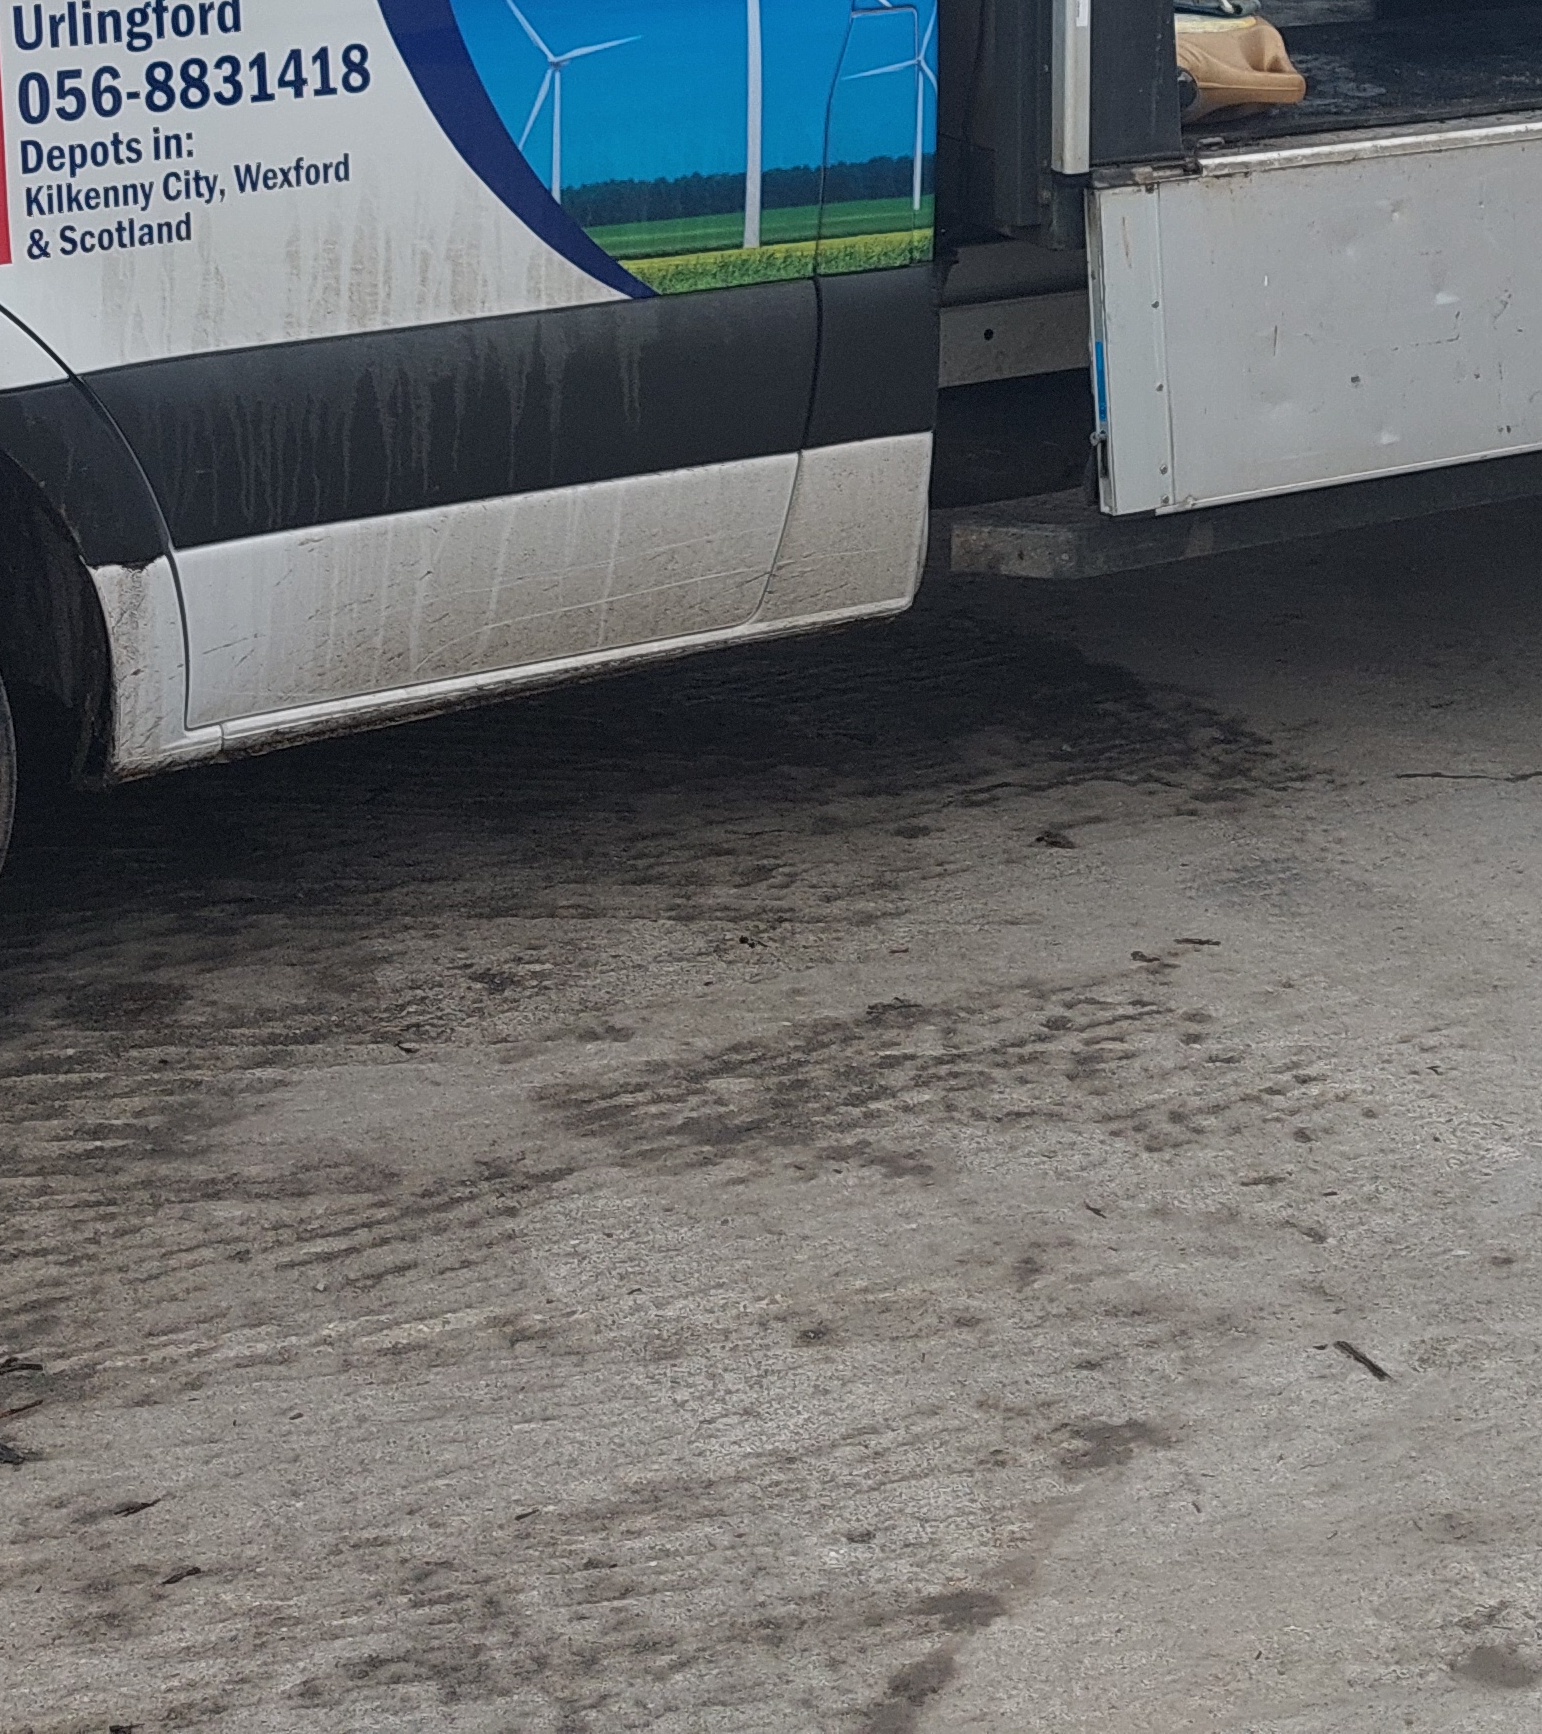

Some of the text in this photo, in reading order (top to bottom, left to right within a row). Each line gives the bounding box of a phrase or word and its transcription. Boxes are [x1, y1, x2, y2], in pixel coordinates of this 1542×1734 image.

[16, 42, 372, 125] 056-8831418
[20, 127, 195, 178] Depots in:
[25, 152, 351, 218] Kilkenny City, Wexford
[26, 212, 192, 261] & Scotland
